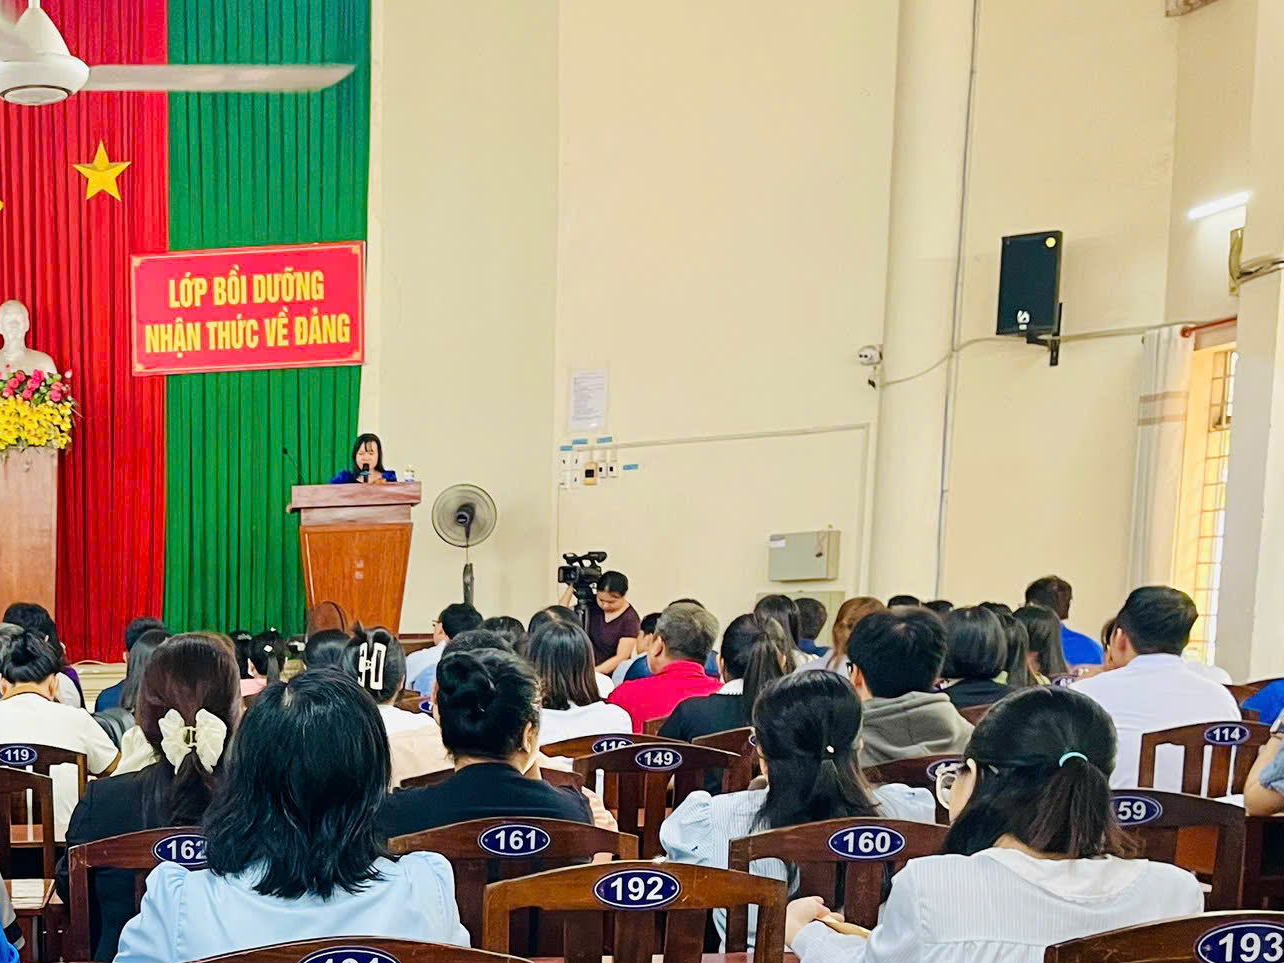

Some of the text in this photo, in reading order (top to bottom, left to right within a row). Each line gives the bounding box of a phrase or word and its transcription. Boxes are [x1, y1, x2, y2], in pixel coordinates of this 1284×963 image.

[169, 264, 324, 309] LỚP BỒI DƯỠNG
[145, 306, 351, 358] NHẬN THỨC VỀ ĐẢNG
[1213, 728, 1241, 741] 114
[5, 749, 29, 761] 119
[644, 752, 673, 766] 149
[167, 840, 207, 860] 162
[495, 830, 536, 850] 161
[843, 832, 890, 853] 160
[611, 877, 663, 901] 192
[1219, 932, 1284, 962] 193
